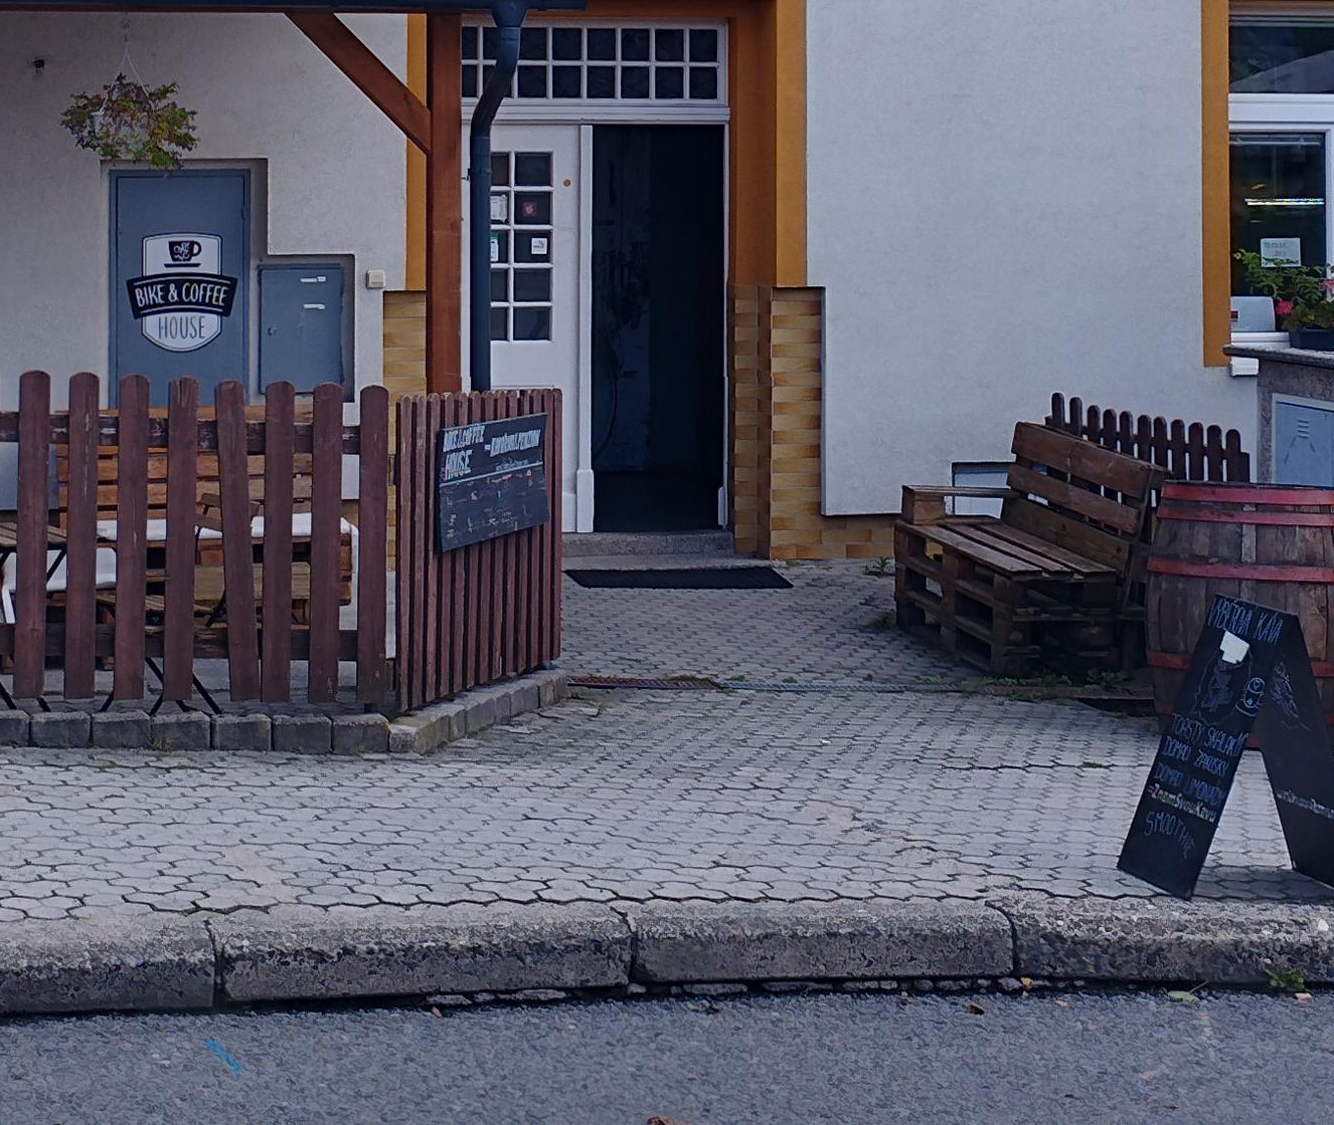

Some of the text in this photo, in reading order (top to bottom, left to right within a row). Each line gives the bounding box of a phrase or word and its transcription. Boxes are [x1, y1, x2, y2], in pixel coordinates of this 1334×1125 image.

[134, 283, 228, 307] BIKE & COFFEE
[158, 316, 205, 339] HOUSE
[445, 449, 473, 481] HOUSE
